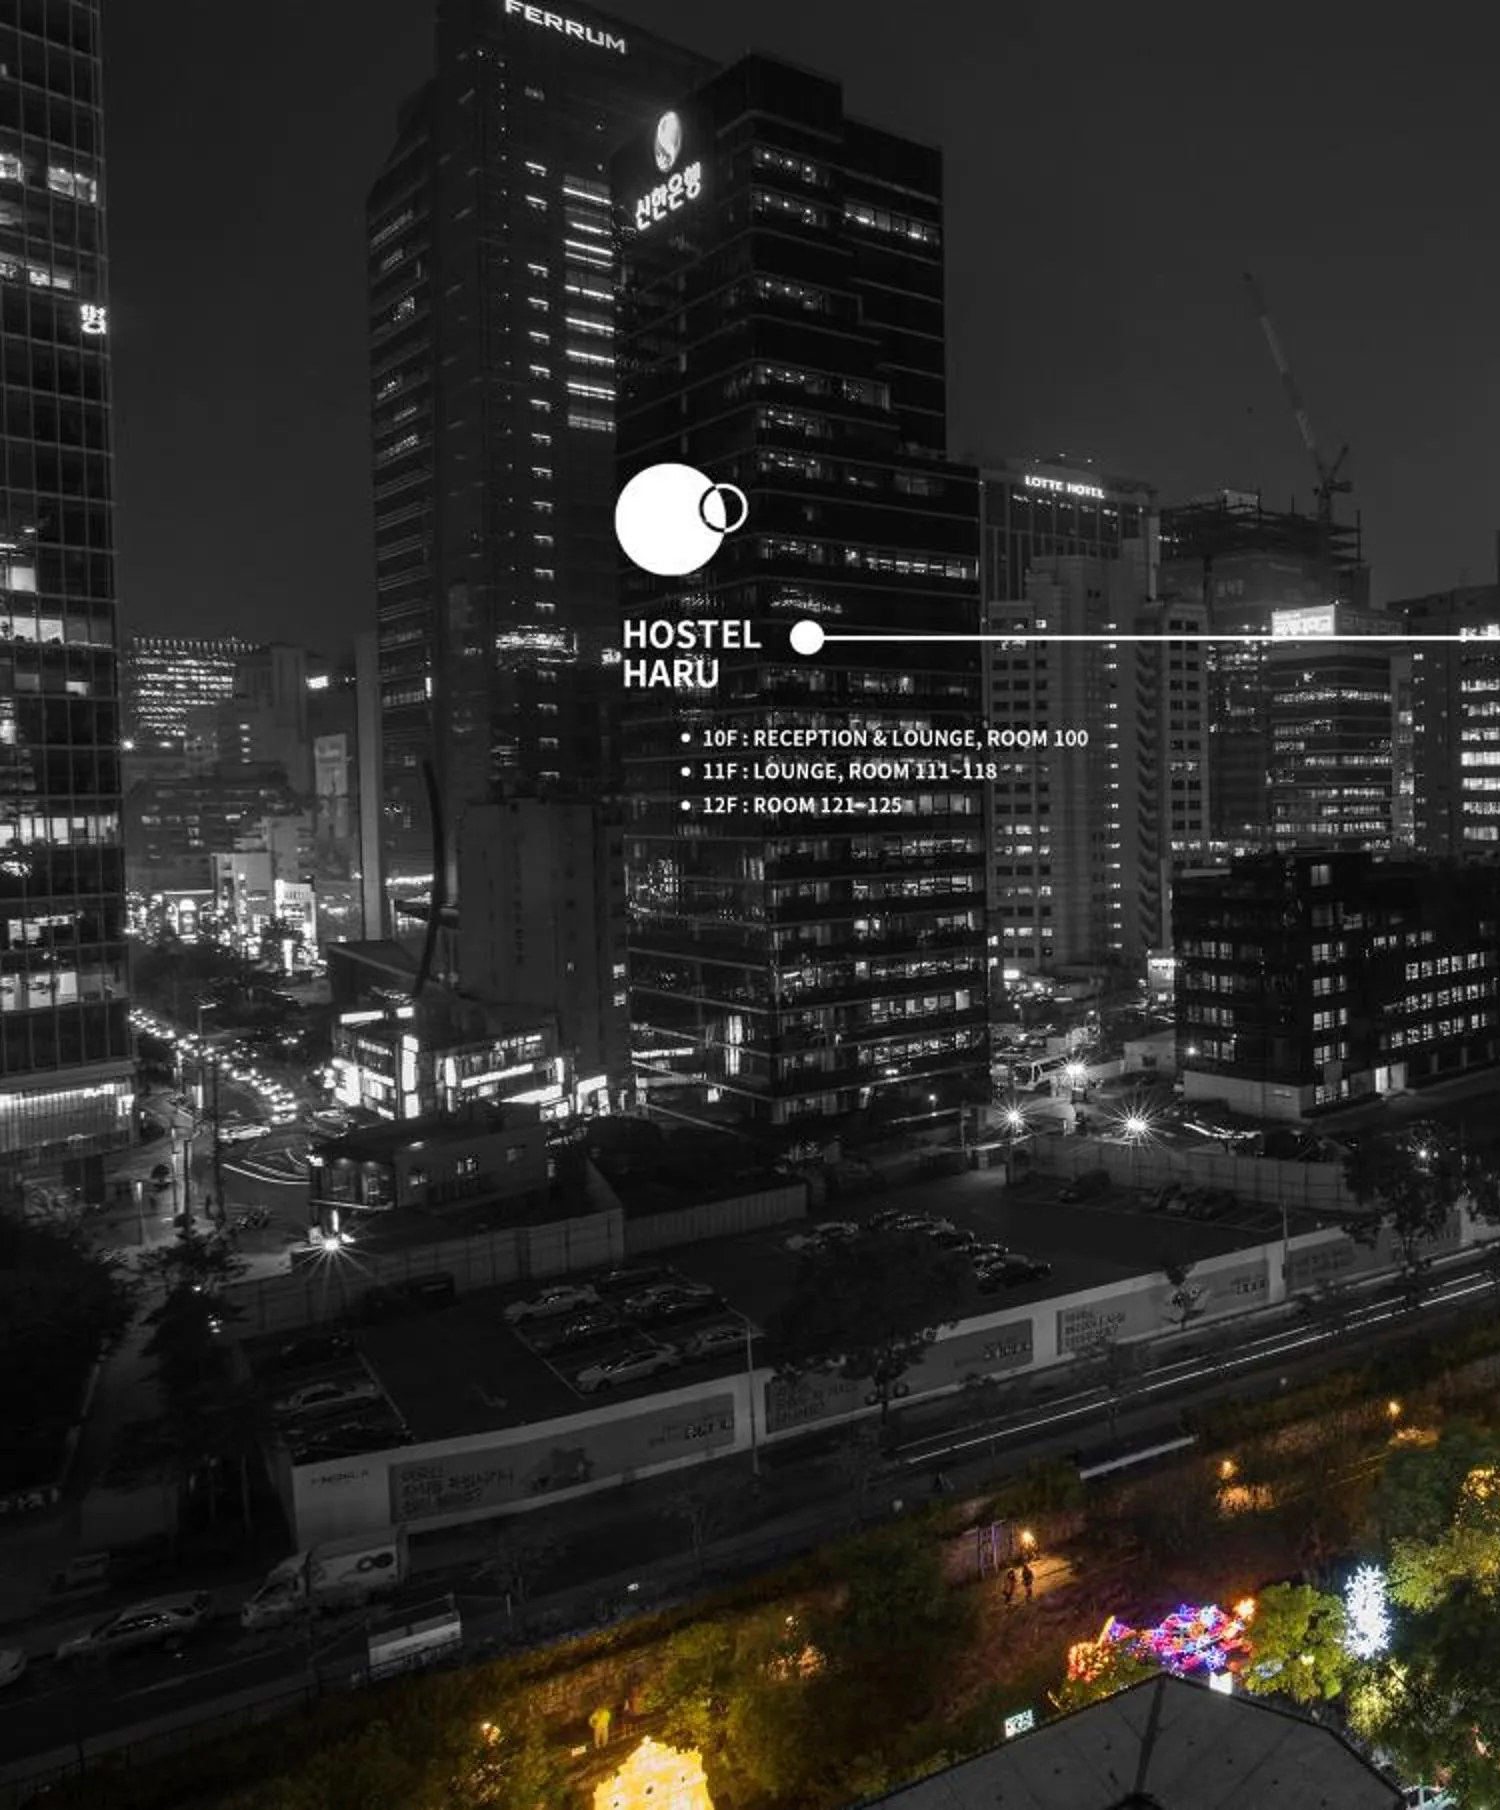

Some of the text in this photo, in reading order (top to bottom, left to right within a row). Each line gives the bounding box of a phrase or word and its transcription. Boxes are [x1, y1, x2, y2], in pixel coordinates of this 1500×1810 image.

[504, 0, 626, 54] FERRUM
[634, 161, 702, 231] 신한은행
[1024, 474, 1105, 500] LOTTE HOTEL
